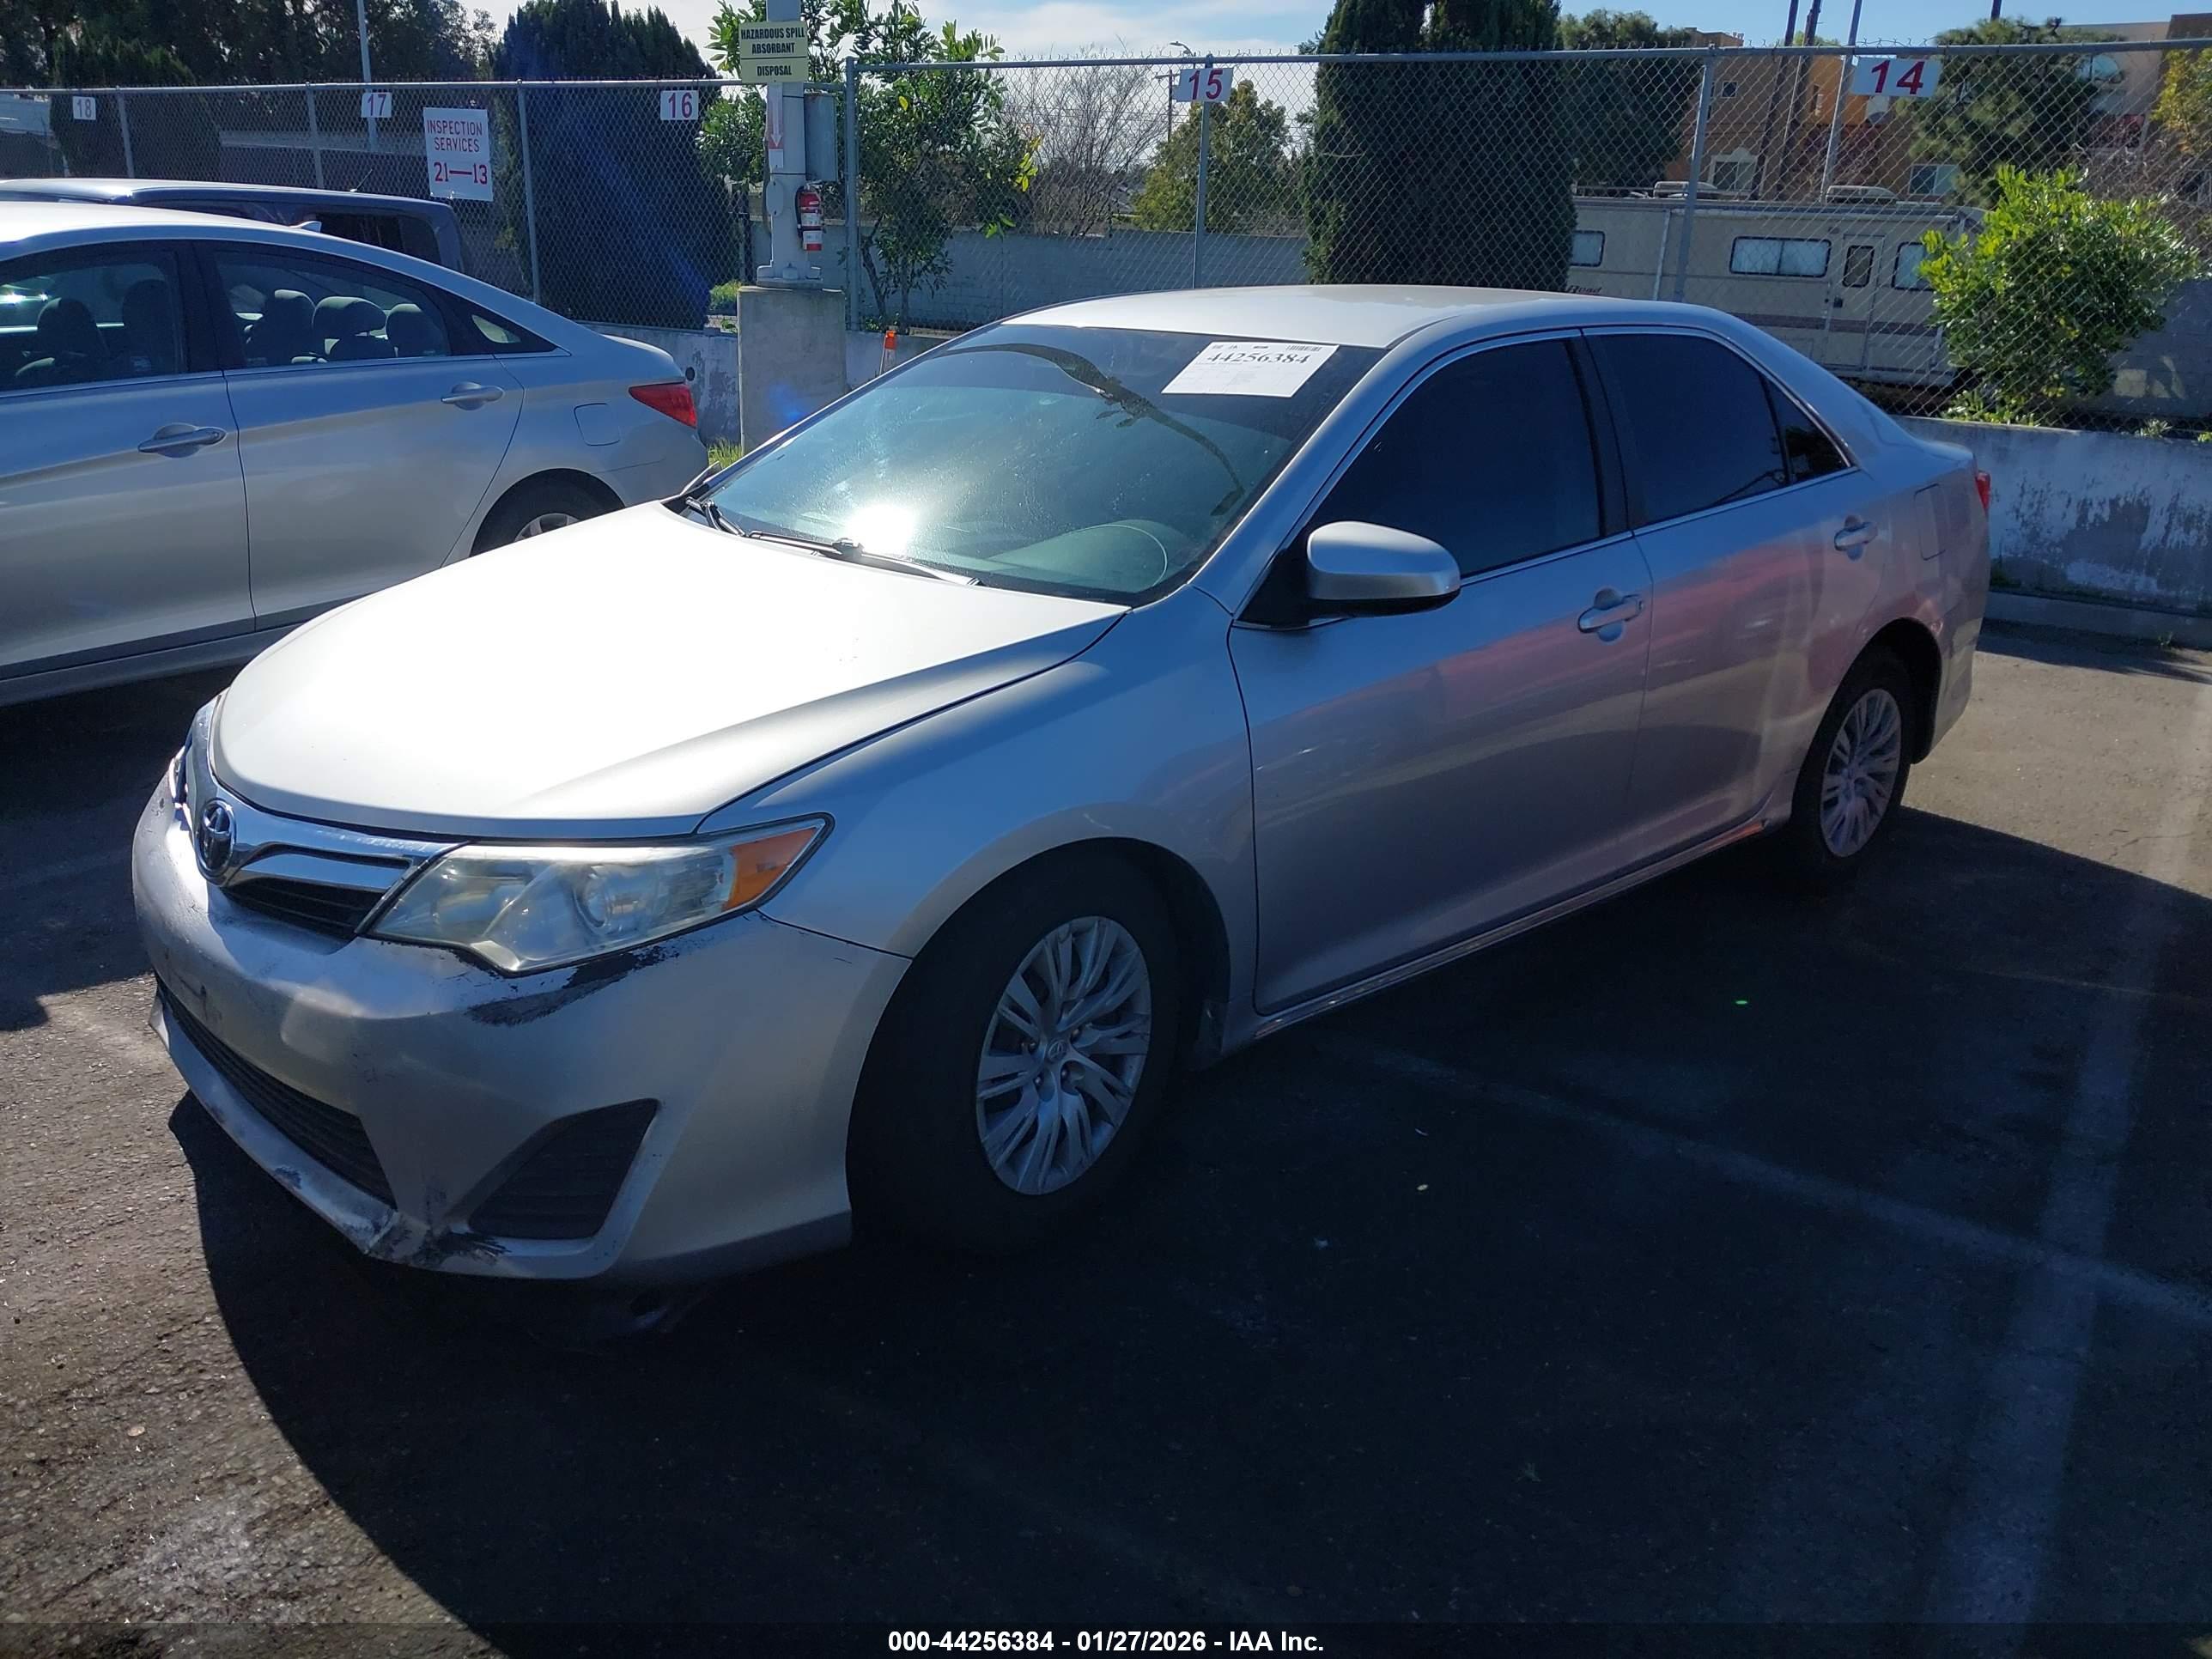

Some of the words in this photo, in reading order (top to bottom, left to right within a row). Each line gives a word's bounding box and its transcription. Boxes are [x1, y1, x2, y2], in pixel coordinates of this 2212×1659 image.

[741, 27, 784, 40] HAZARDOUS
[786, 27, 805, 39] SPILL
[752, 43, 795, 54] ABSORBANT
[757, 65, 793, 76] DISPOSAL
[1871, 60, 1925, 94] 14
[1188, 69, 1224, 100] 15
[77, 99, 92, 118] 18
[368, 94, 386, 116] 17
[668, 92, 693, 118] 16
[427, 119, 483, 136] INSPECTION
[434, 137, 480, 153] SERVICES
[1207, 352, 1311, 364] 44256384
